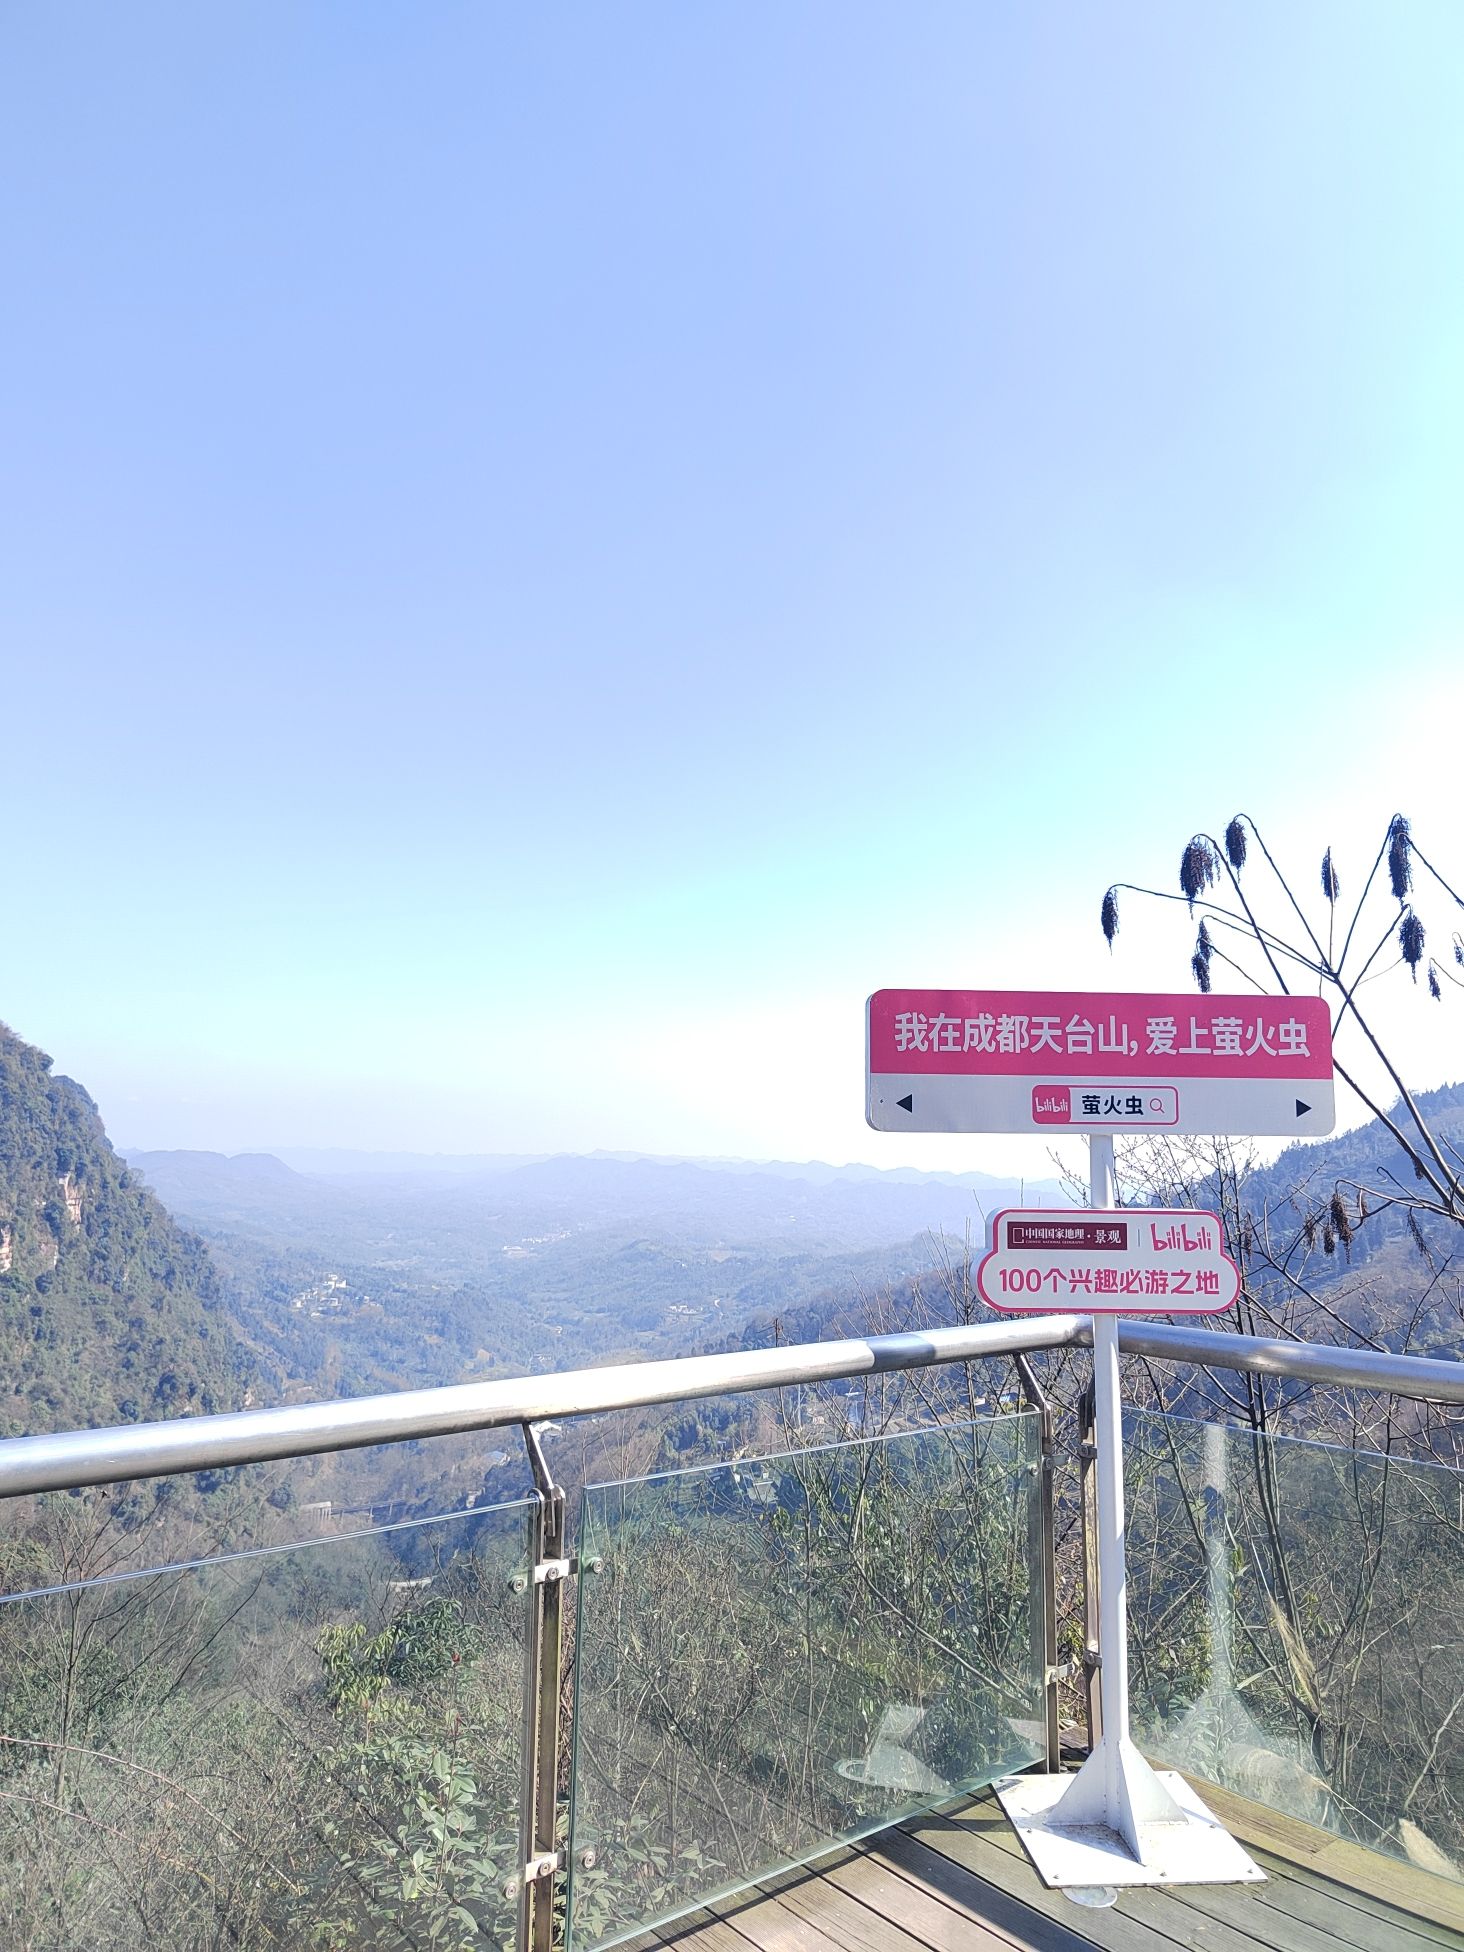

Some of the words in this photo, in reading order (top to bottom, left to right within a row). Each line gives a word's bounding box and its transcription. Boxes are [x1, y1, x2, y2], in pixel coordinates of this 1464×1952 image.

[1035, 1097, 1068, 1112] bilibili
[1082, 1095, 1144, 1115] 萤火虫
[1150, 1223, 1212, 1251] bilibili
[999, 1268, 1220, 1295] 100个兴趣必游之地
